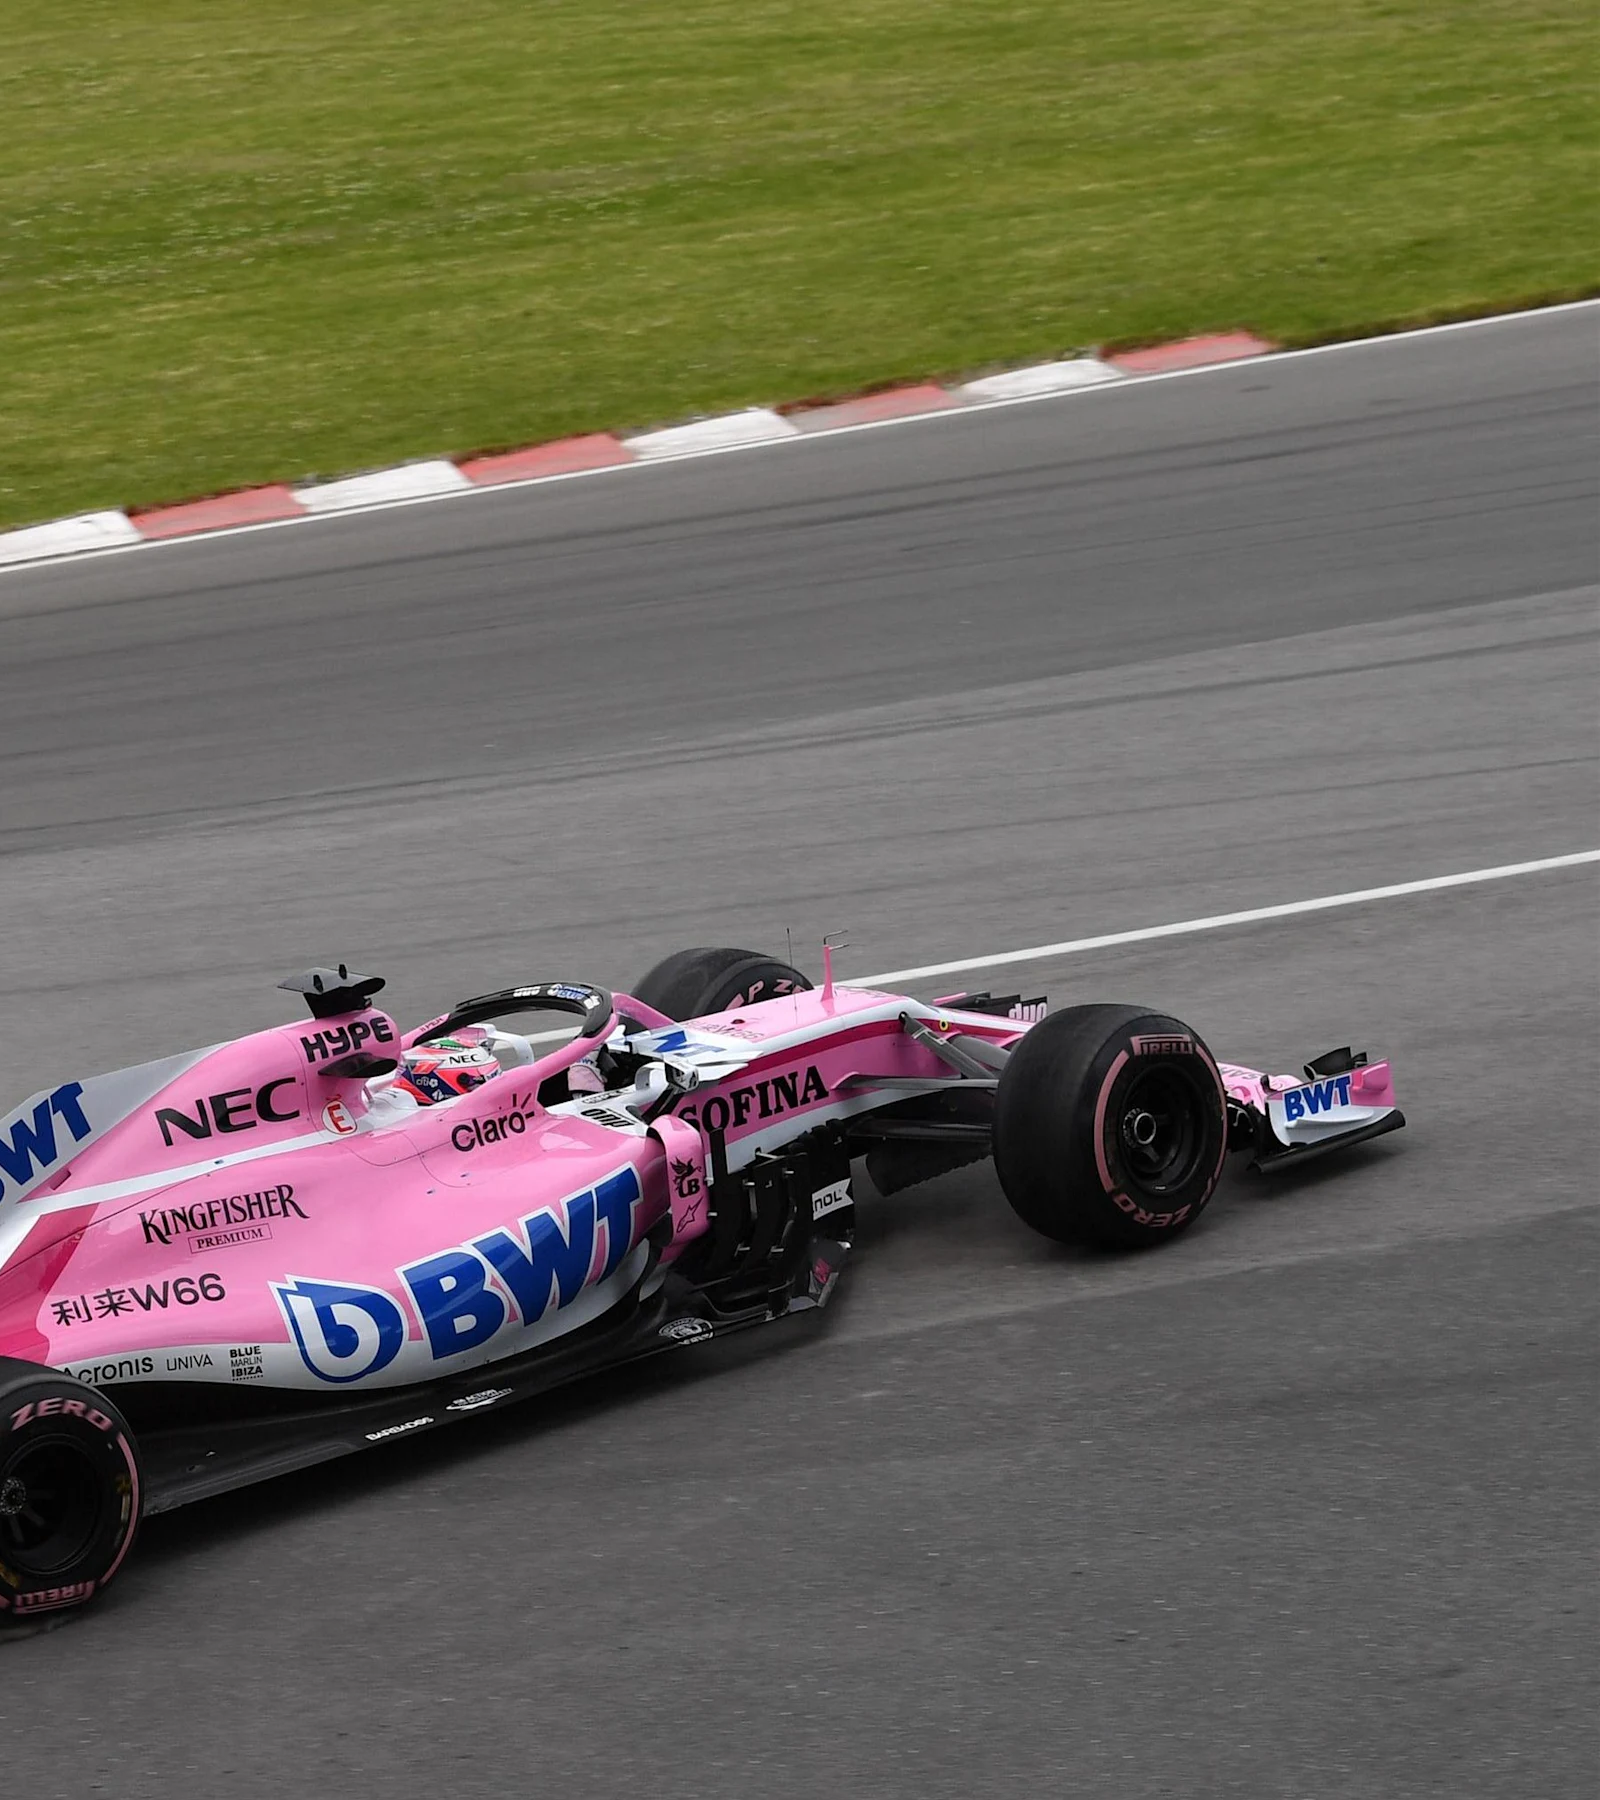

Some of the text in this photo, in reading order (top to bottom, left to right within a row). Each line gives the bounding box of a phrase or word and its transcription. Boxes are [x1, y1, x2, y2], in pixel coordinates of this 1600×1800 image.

[748, 980, 764, 1003] P
[300, 1016, 393, 1064] HYPE
[1130, 1034, 1193, 1056] PIRELLI
[449, 1054, 481, 1065] NEC
[154, 1076, 300, 1147] NEC
[677, 1064, 829, 1134] SOFINA
[1284, 1075, 1351, 1122] BWT
[326, 1103, 353, 1133] E
[451, 1109, 528, 1153] Claro
[137, 1183, 309, 1246] KINGFISHER
[1112, 1192, 1192, 1228] ZERO
[195, 1227, 265, 1250] PREMIUM
[401, 1165, 640, 1360] BWT
[51, 1272, 226, 1328] 利来W66
[166, 1354, 214, 1373] UNIVA
[229, 1345, 262, 1359] BLUE
[230, 1354, 263, 1368] MARLIN
[230, 1364, 263, 1378] IBIZA
[9, 1397, 114, 1432] ZERO
[13, 1580, 96, 1614] PIRELLI
